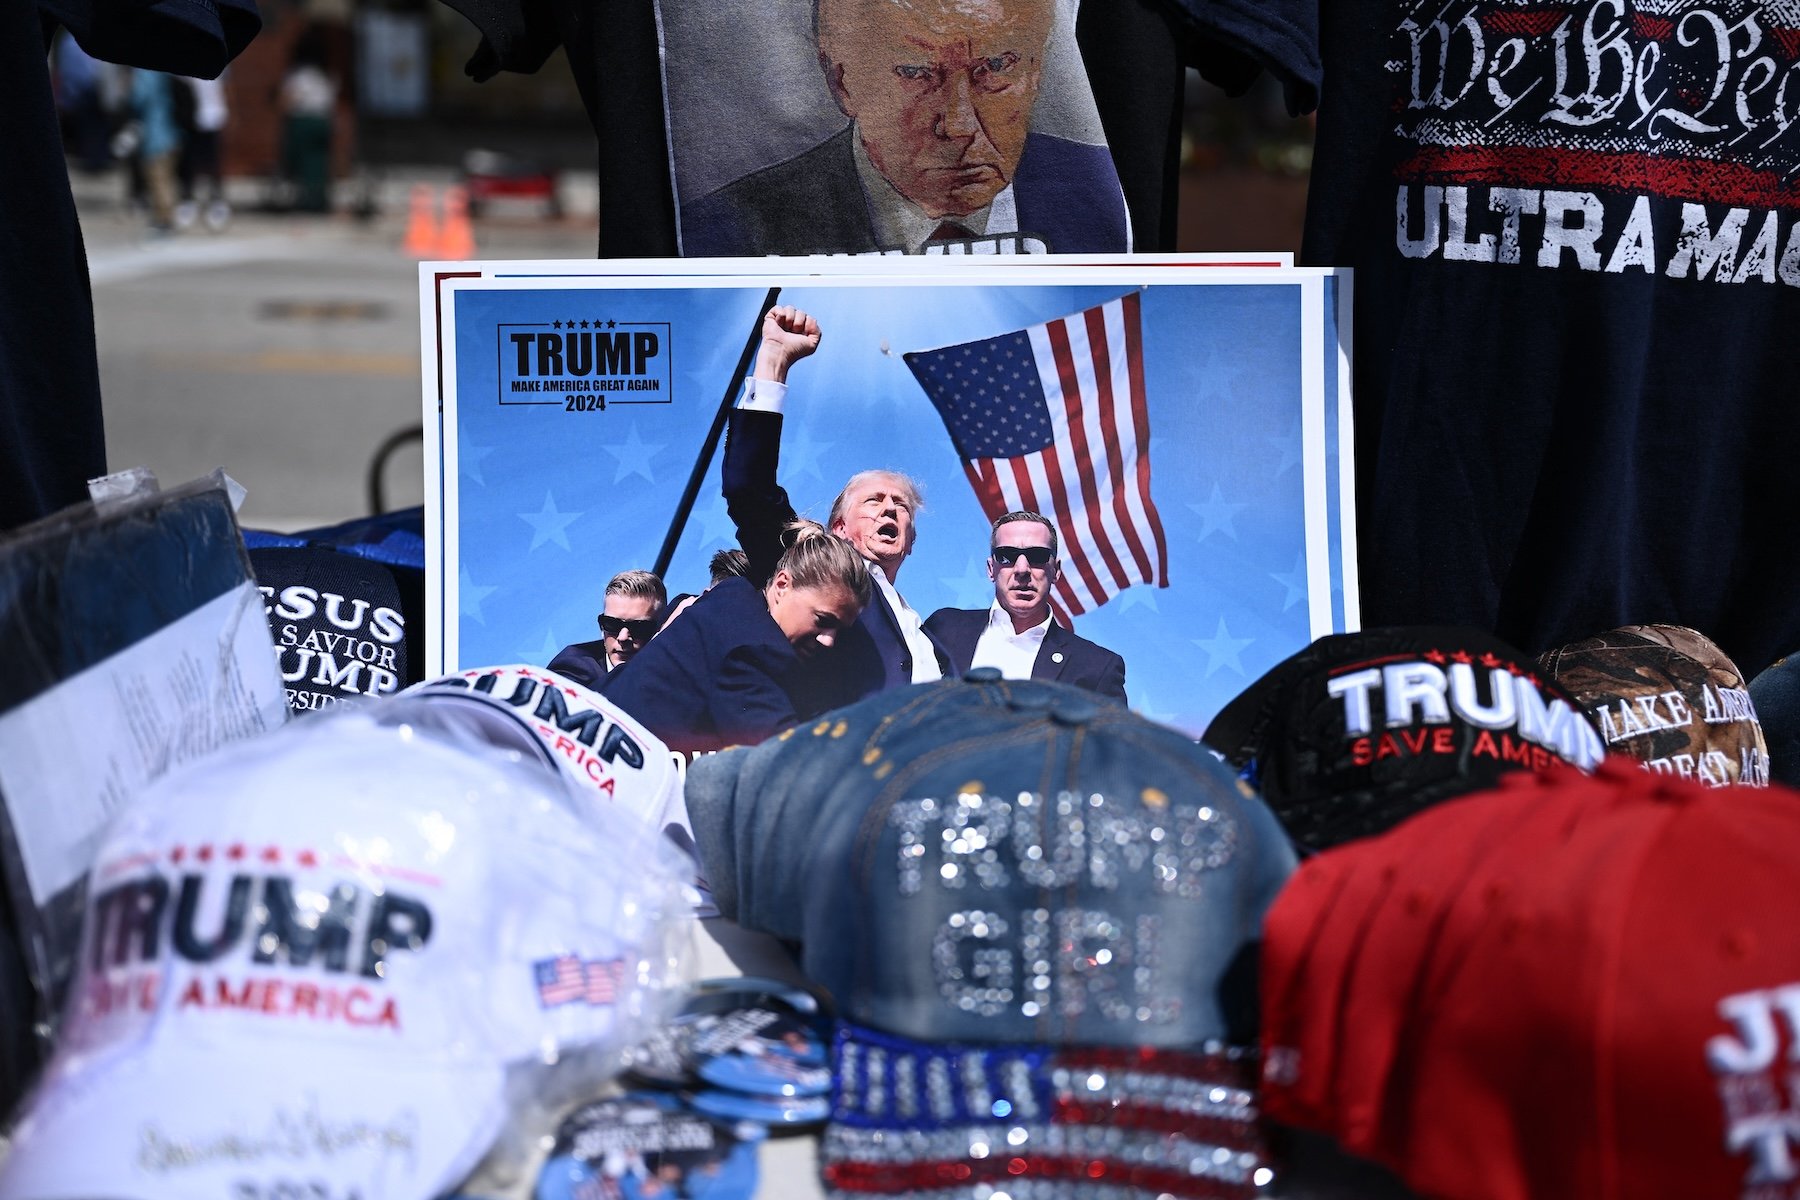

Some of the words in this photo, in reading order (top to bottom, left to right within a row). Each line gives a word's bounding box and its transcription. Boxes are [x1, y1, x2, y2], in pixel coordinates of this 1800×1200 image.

[1396, 185, 1656, 274] ULTRA
[510, 332, 659, 376] TRUMP
[511, 381, 541, 392] MAKE
[542, 381, 591, 392] AMERICA
[593, 380, 625, 391] GREAT
[627, 379, 660, 391] AGAIN
[565, 394, 606, 411] 2024
[280, 624, 398, 671] SAVIOR
[1352, 728, 1456, 767] SAVE
[890, 789, 1239, 897] TRUMP
[931, 908, 1182, 1020] GIRL
[177, 976, 402, 1030] AMERICA
